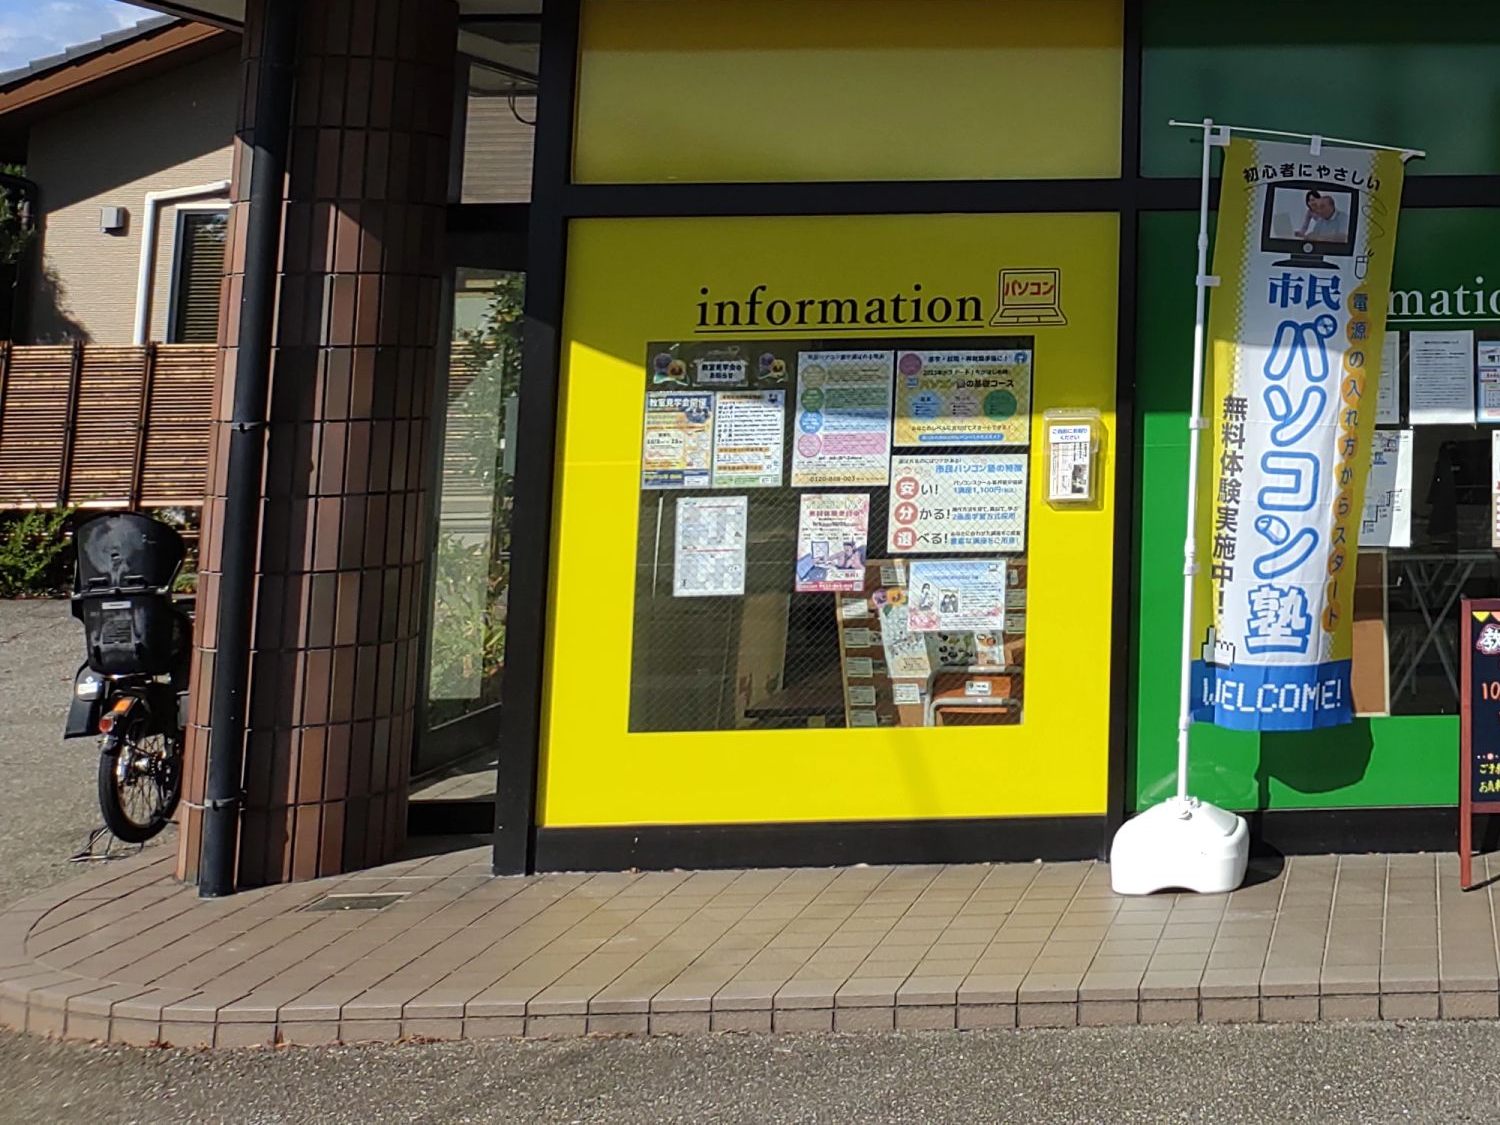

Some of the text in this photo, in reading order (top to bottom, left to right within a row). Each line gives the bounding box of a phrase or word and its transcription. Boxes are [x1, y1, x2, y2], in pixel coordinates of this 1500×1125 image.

[1243, 163, 1381, 192] 初心者にやさしい
[696, 284, 985, 327] information
[1004, 280, 1055, 297] パソコン
[1268, 273, 1342, 311] 市民
[1327, 292, 1370, 627] 電源の入れ方からスタート
[1244, 313, 1338, 654] パソコン塾
[1211, 394, 1248, 615] 無料体験実施中!
[1202, 677, 1342, 713] WELCOME!
